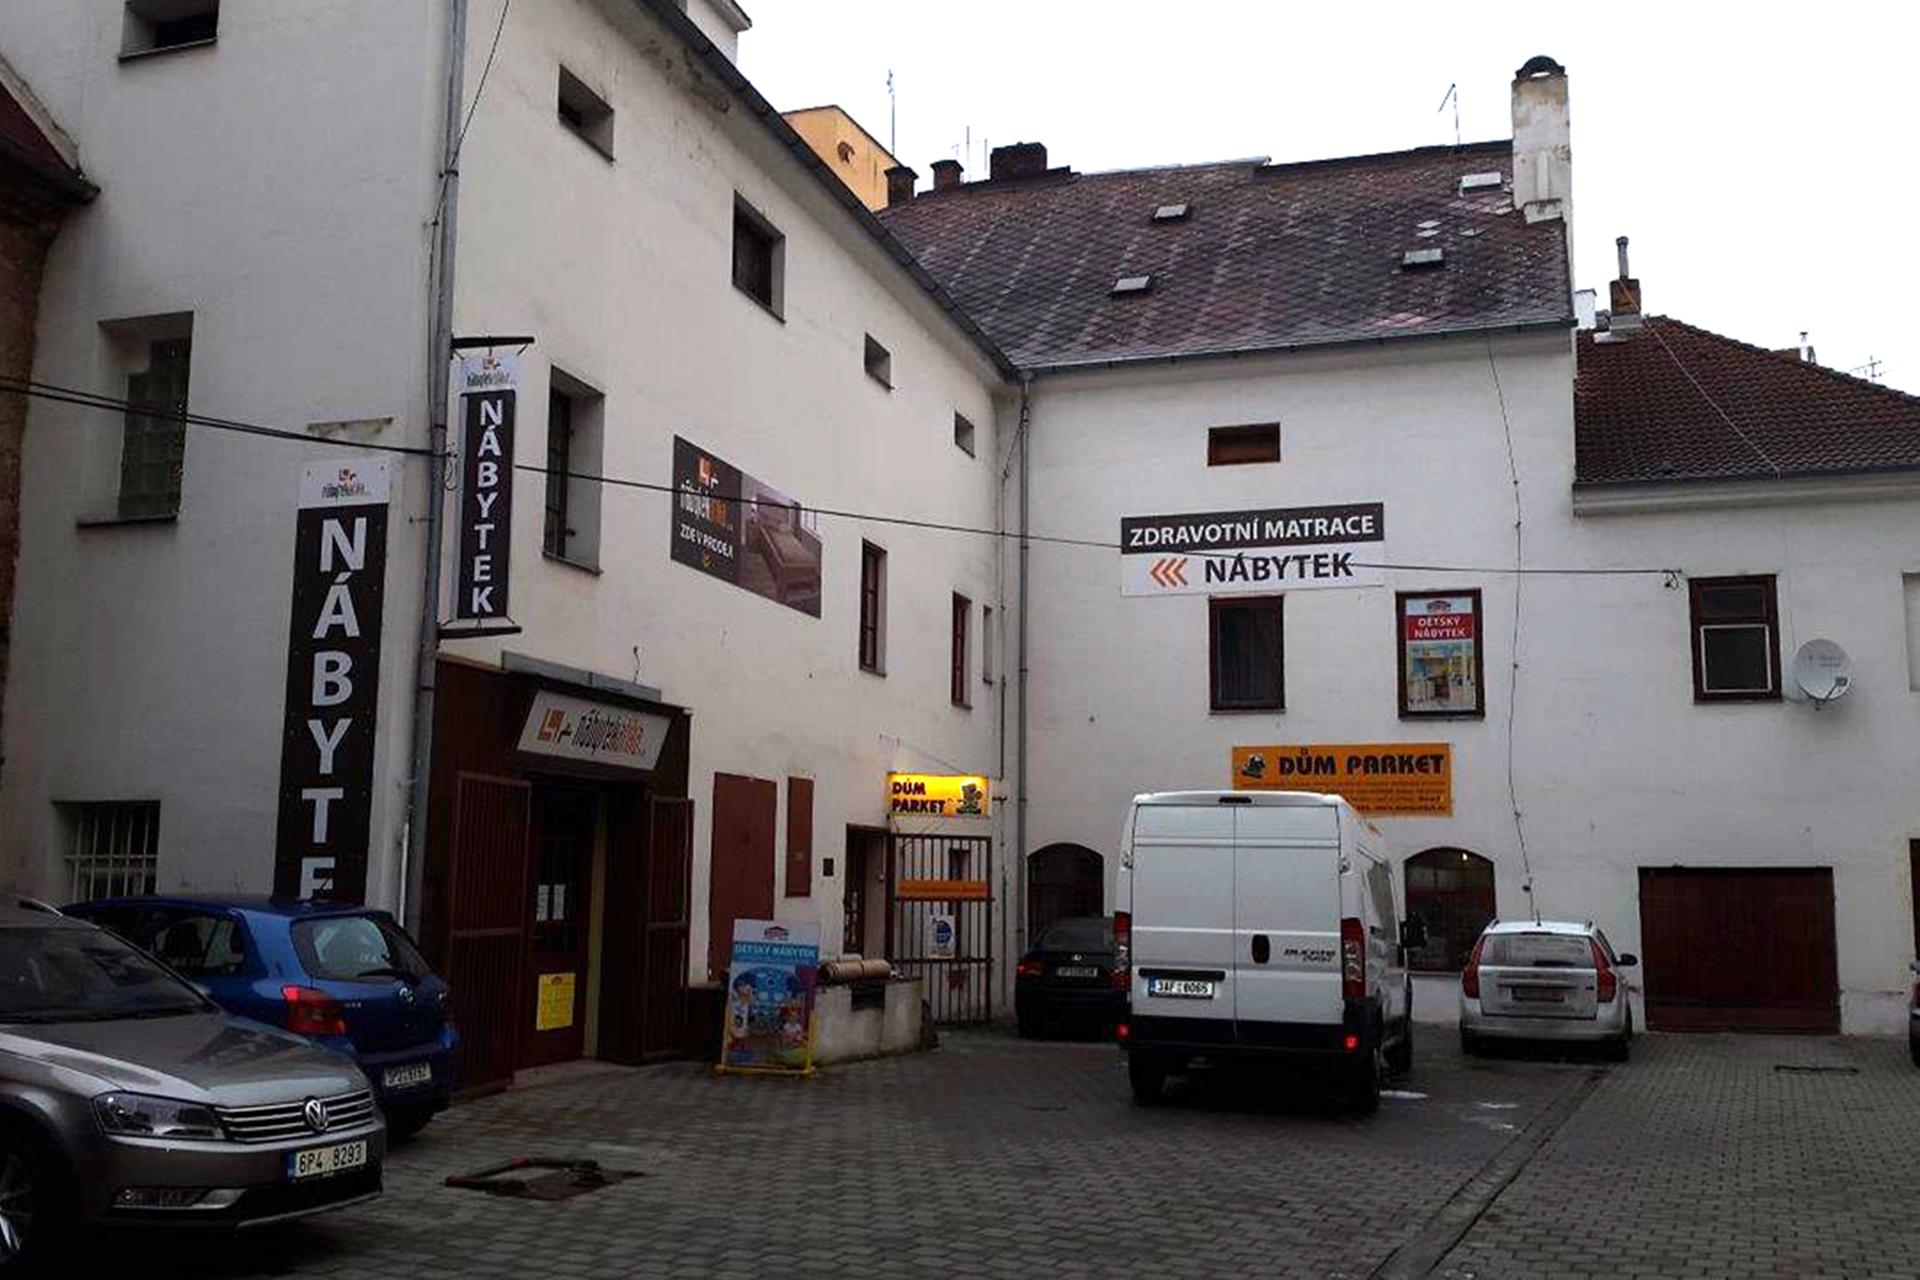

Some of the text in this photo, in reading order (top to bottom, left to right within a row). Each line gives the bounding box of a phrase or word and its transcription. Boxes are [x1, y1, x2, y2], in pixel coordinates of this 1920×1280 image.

[470, 399, 504, 614] NÁBYTEK
[1129, 515, 1376, 547] ZDRAVOTNÍ MATRACE
[1204, 551, 1354, 583] NÁBYTEK
[1414, 626, 1467, 639] NÁBYTEK
[1279, 747, 1445, 776] DŮM PARKET
[892, 798, 946, 814] PARKET
[299, 1144, 362, 1174] 6P4 8293
